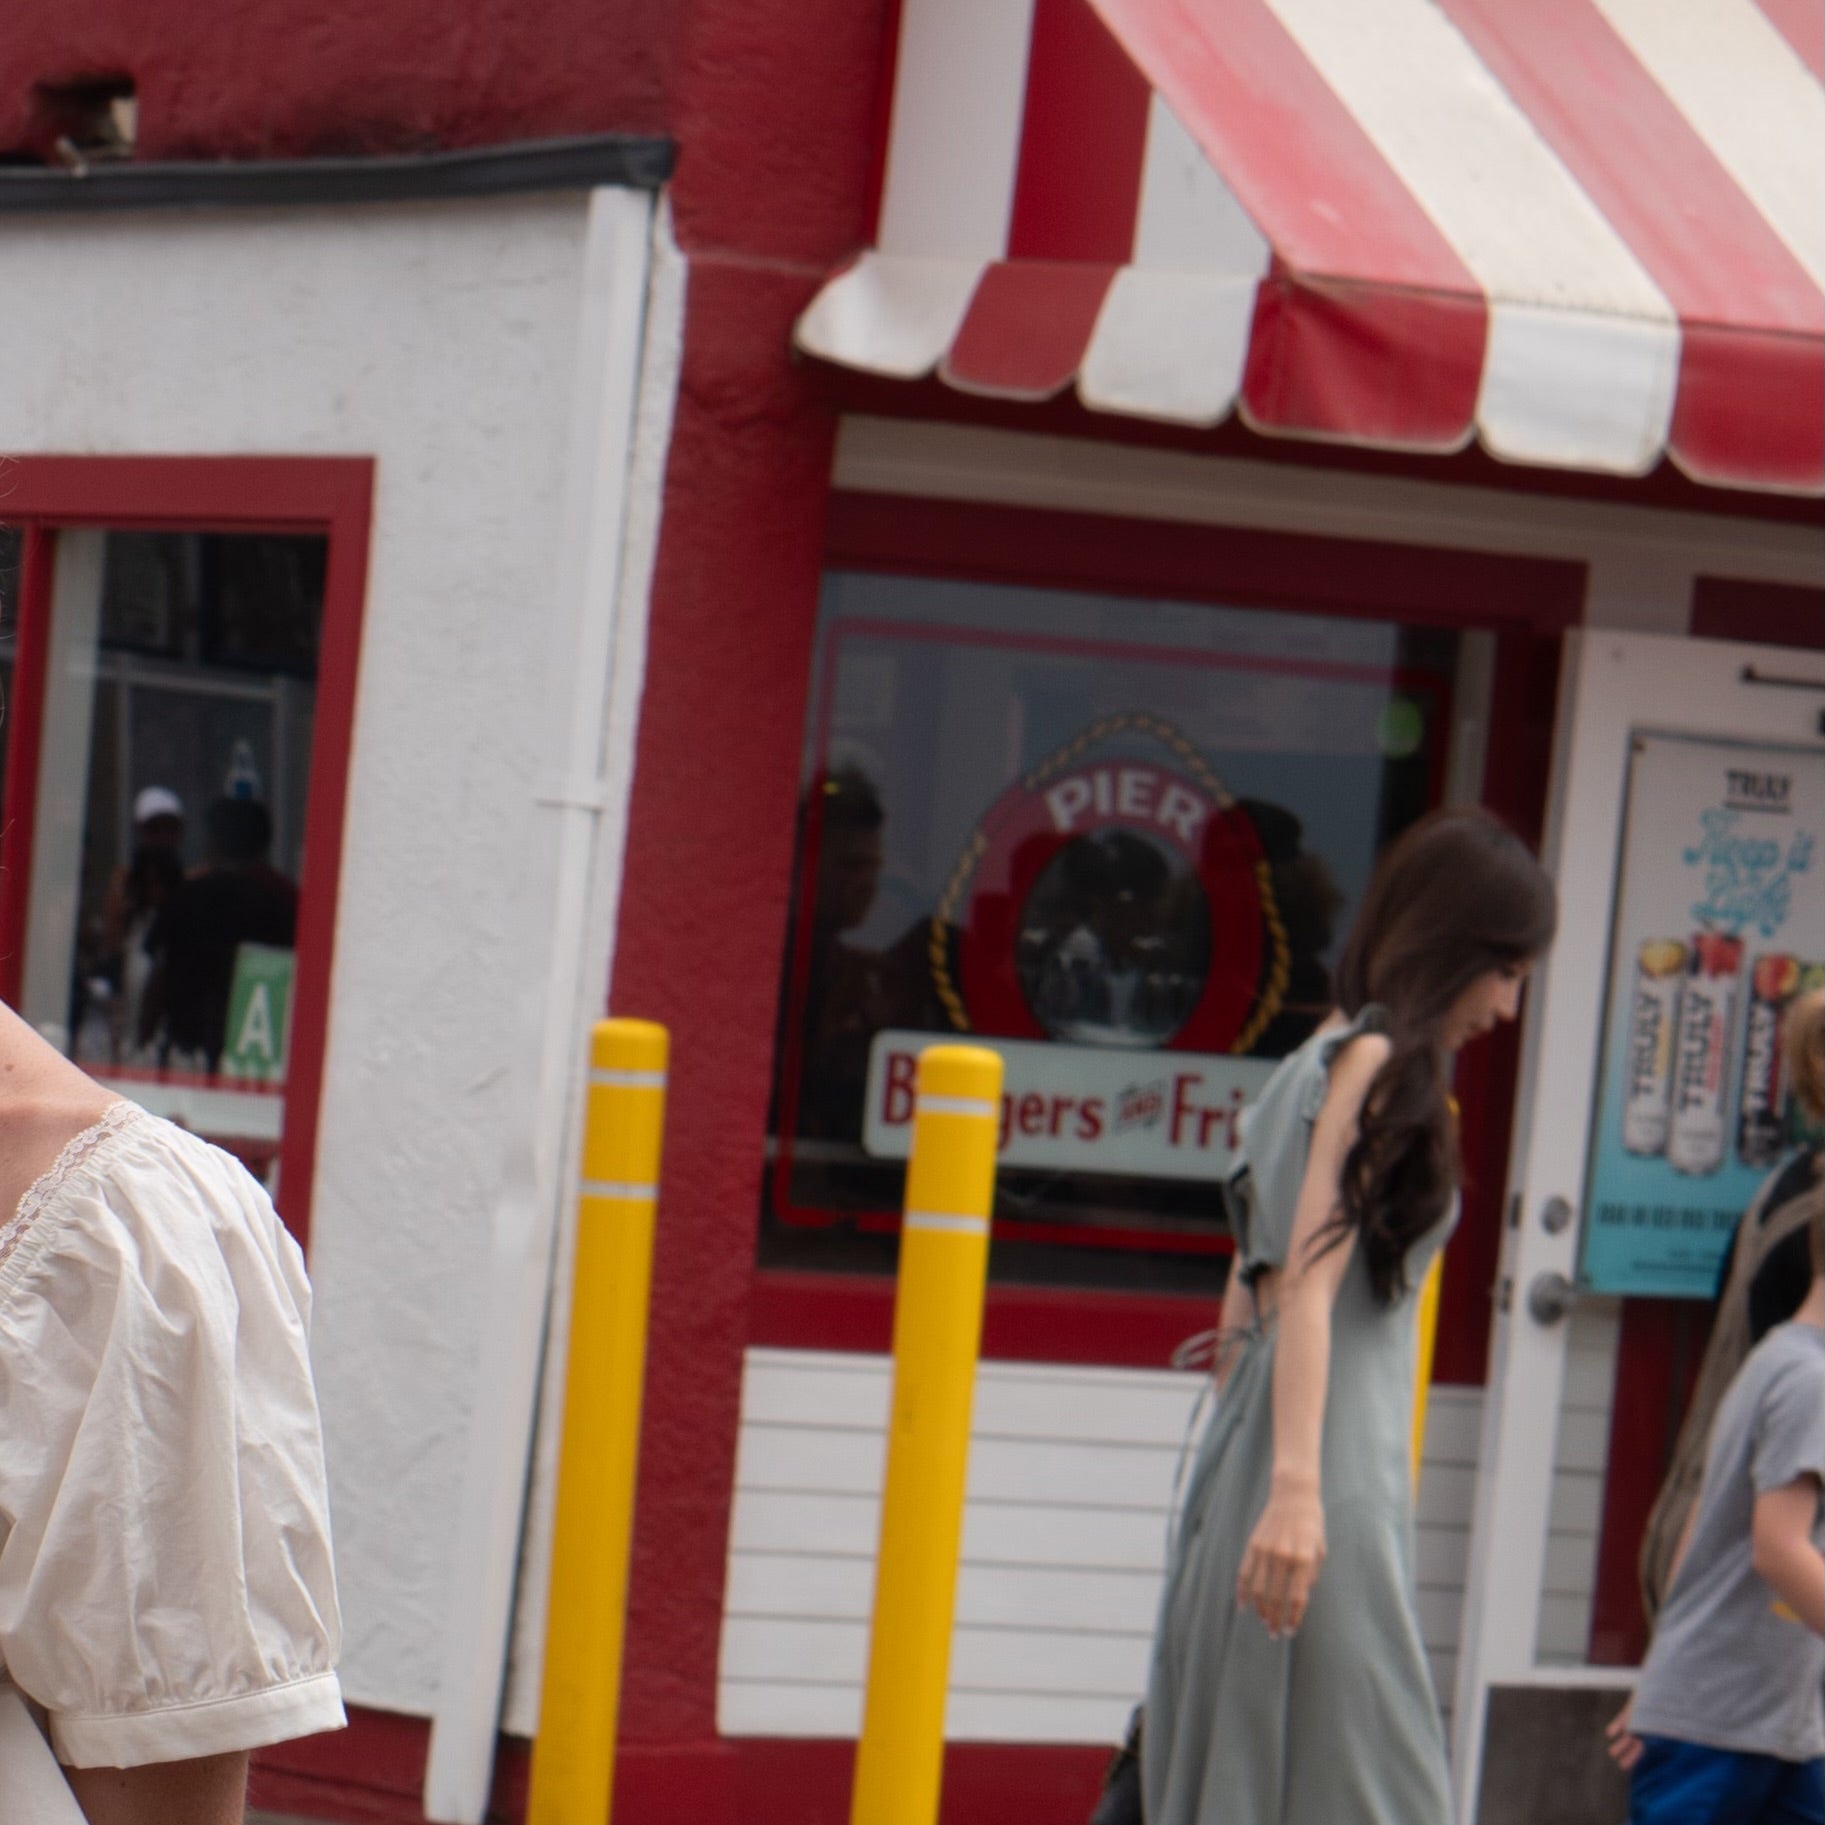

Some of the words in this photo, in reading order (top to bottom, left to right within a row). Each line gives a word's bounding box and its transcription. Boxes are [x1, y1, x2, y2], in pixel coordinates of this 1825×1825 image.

[1045, 768, 1207, 842] PIER
[234, 983, 275, 1057] A
[882, 1051, 1104, 1153] Bgers
